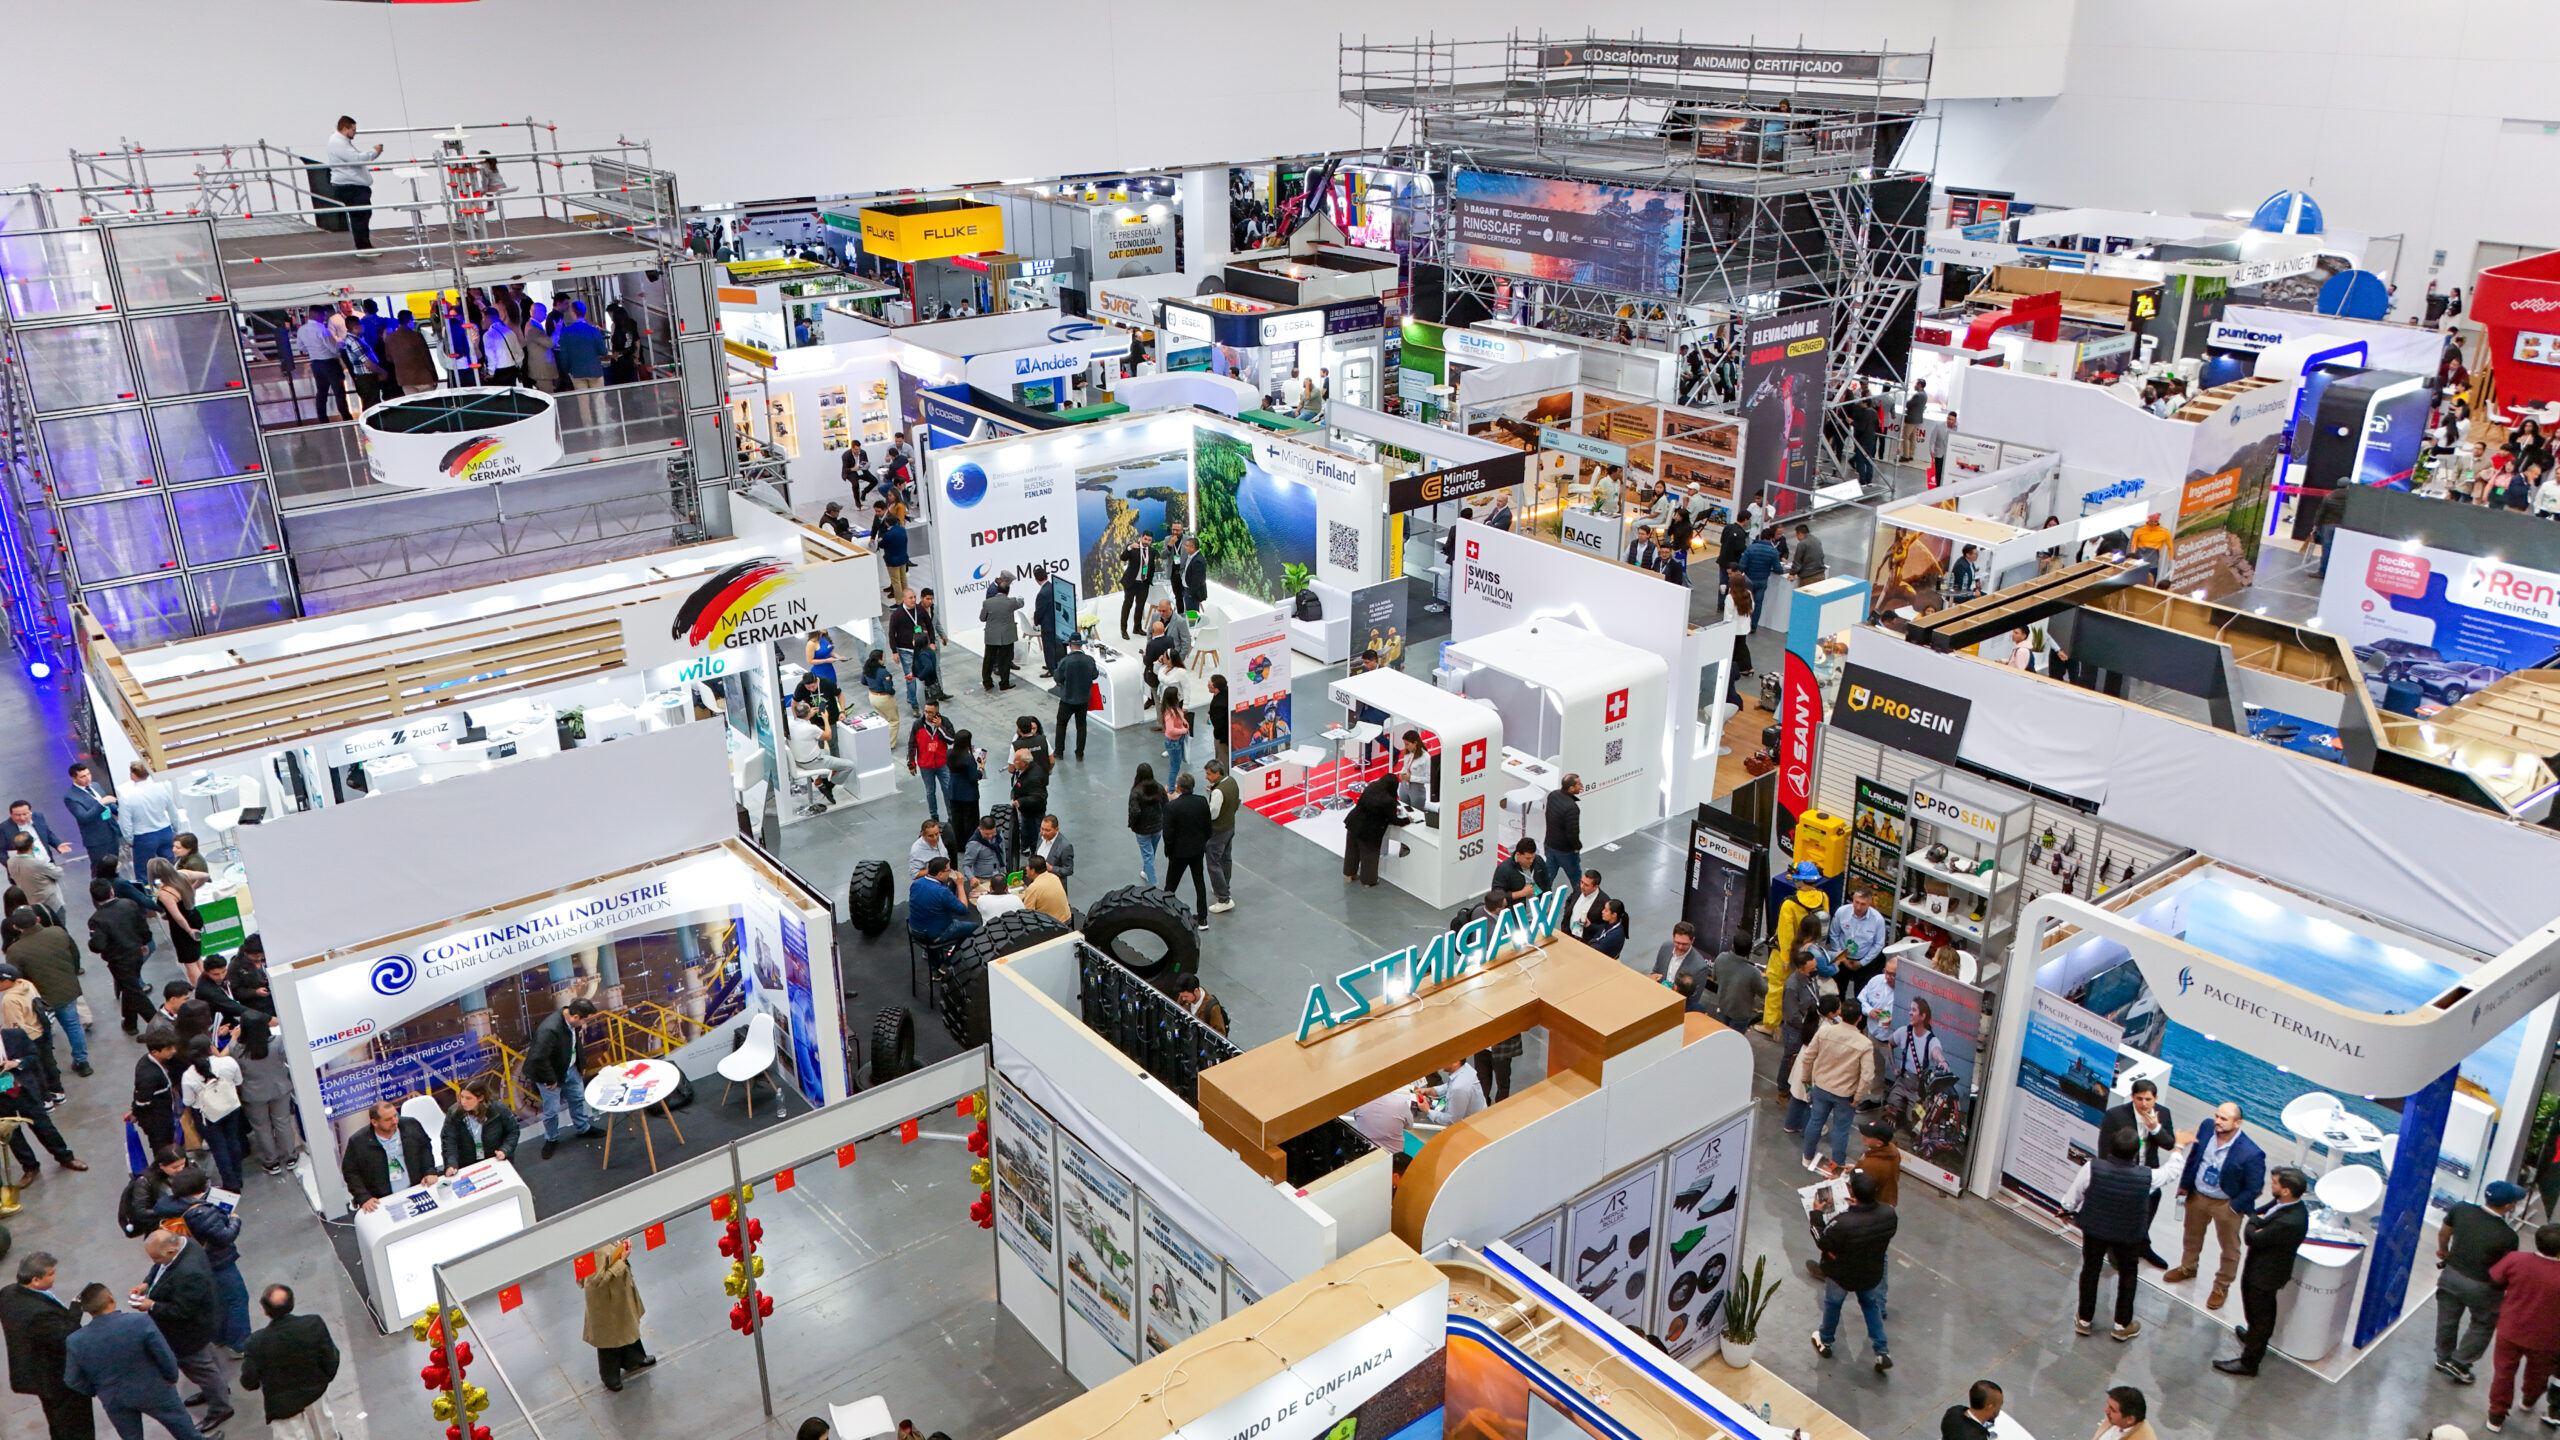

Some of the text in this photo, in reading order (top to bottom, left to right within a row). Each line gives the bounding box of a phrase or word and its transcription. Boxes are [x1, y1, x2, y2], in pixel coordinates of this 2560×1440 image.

[1603, 51, 1679, 66] scafom-rux
[1694, 55, 1843, 74] ANDAMIO CERTIFICADO
[1470, 205, 1499, 216] BAGANT
[866, 225, 895, 241] FLUKE
[924, 225, 978, 241] FLUKE
[1109, 228, 1162, 241] TE PRESENTA LA
[1463, 216, 1522, 236] RINGSCAFF
[1463, 230, 1487, 241] ANDAMIO
[1487, 233, 1522, 246] CERTIFICADO
[1109, 246, 1163, 260] CAT COMMAND
[1937, 247, 1961, 255] HEXAGON
[2234, 254, 2318, 282] ALFRED H KNIGHT
[1752, 319, 1819, 346] ELEVACIÓN DE
[1459, 334, 1505, 352] EURO
[1788, 338, 1824, 355] PALFINGER
[1031, 354, 1079, 375] Anddes
[1577, 442, 1609, 455] ACE GROUP
[466, 455, 515, 473] MADE IN
[468, 464, 522, 482] GERMANY
[1281, 449, 1315, 475] Mining
[1316, 460, 1356, 486] Finland
[1024, 478, 1055, 491] BUSINESS
[1443, 468, 1480, 486] Mining
[1024, 487, 1053, 499] FINLAND
[1442, 477, 1486, 498] Services
[970, 515, 1048, 548] normet
[1575, 530, 1601, 549] ACE
[2177, 532, 2227, 557] Soluciones
[2378, 554, 2415, 569] Recibe
[1468, 565, 1500, 585] SWISS
[2376, 563, 2421, 580] asesoría
[953, 581, 991, 596] WÄRTSIL
[1467, 579, 1513, 603] PAVILION
[721, 597, 807, 631] MADE IN
[2484, 596, 2549, 619] Pichincha
[723, 614, 819, 649] GERMANY
[679, 656, 725, 683] wilo
[1335, 690, 1350, 706] SGS
[1794, 683, 1811, 764] SANY
[1871, 695, 1954, 735] PROSEIN
[345, 721, 449, 755] Entek zienz
[500, 742, 517, 752] AHK
[1460, 773, 1486, 785] Suiza.
[1584, 782, 1597, 792] BG
[1928, 798, 1996, 834] PROSEIN
[1458, 838, 1484, 862] SGS
[1709, 841, 1748, 864] PROSEIN
[422, 881, 669, 964] CONTINENTAL INDUSTRIE
[426, 897, 672, 979] CENTRIFUGAL BLOWERS FOR FLOTATION
[1911, 975, 1930, 990] Con
[2044, 1003, 2114, 1045] PACIFIC TERMINAL
[2204, 984, 2365, 1059] PACIFIC TERMINAL
[309, 1023, 371, 1049] SPINPERU
[318, 1037, 466, 1092] COMPRESORES CENTRIFUGOS
[321, 1073, 394, 1102] PARA MINERÍA
[397, 1078, 415, 1088] 1.000
[1696, 1152, 1722, 1171] AMERICAN
[1698, 1160, 1719, 1174] ROLLER
[1943, 1172, 1954, 1183] 3M
[1599, 1205, 1629, 1224] AMERICAN
[1602, 1213, 1625, 1228] ROLLER
[1228, 1347, 1393, 1440] UNDO DE CONFIANZA
